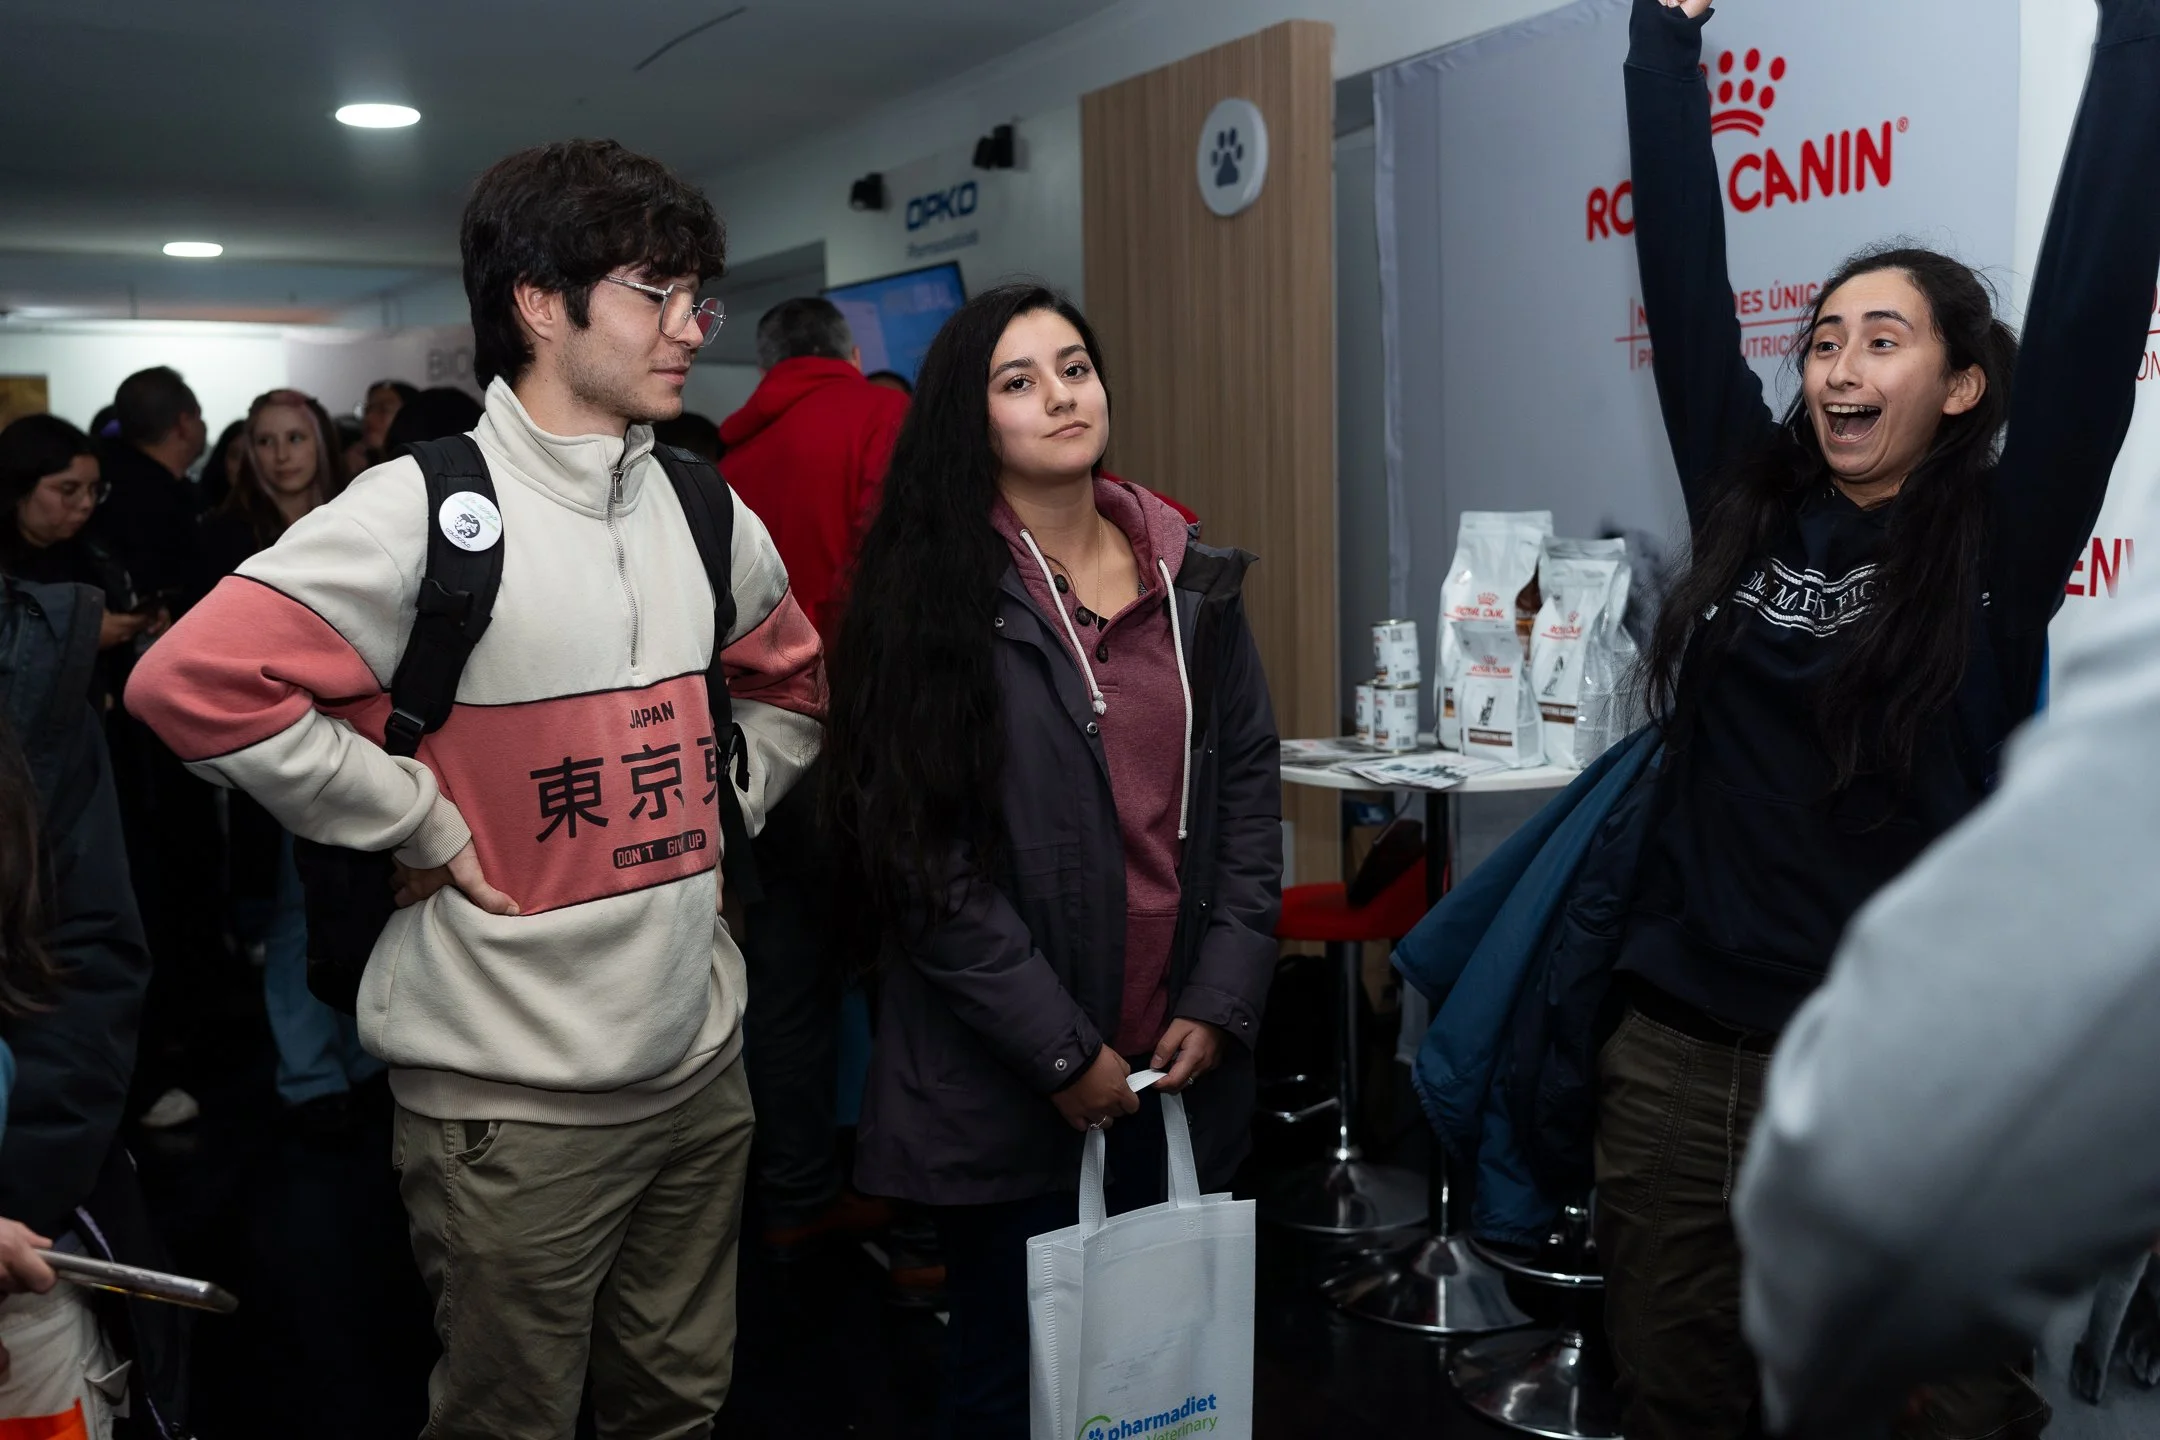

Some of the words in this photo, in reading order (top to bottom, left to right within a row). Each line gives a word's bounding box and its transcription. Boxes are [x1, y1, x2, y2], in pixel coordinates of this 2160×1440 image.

[906, 180, 977, 231] OPKO
[629, 700, 675, 729] JAPAN
[688, 832, 703, 849] UP
[1108, 1393, 1217, 1440] pharmadiet
